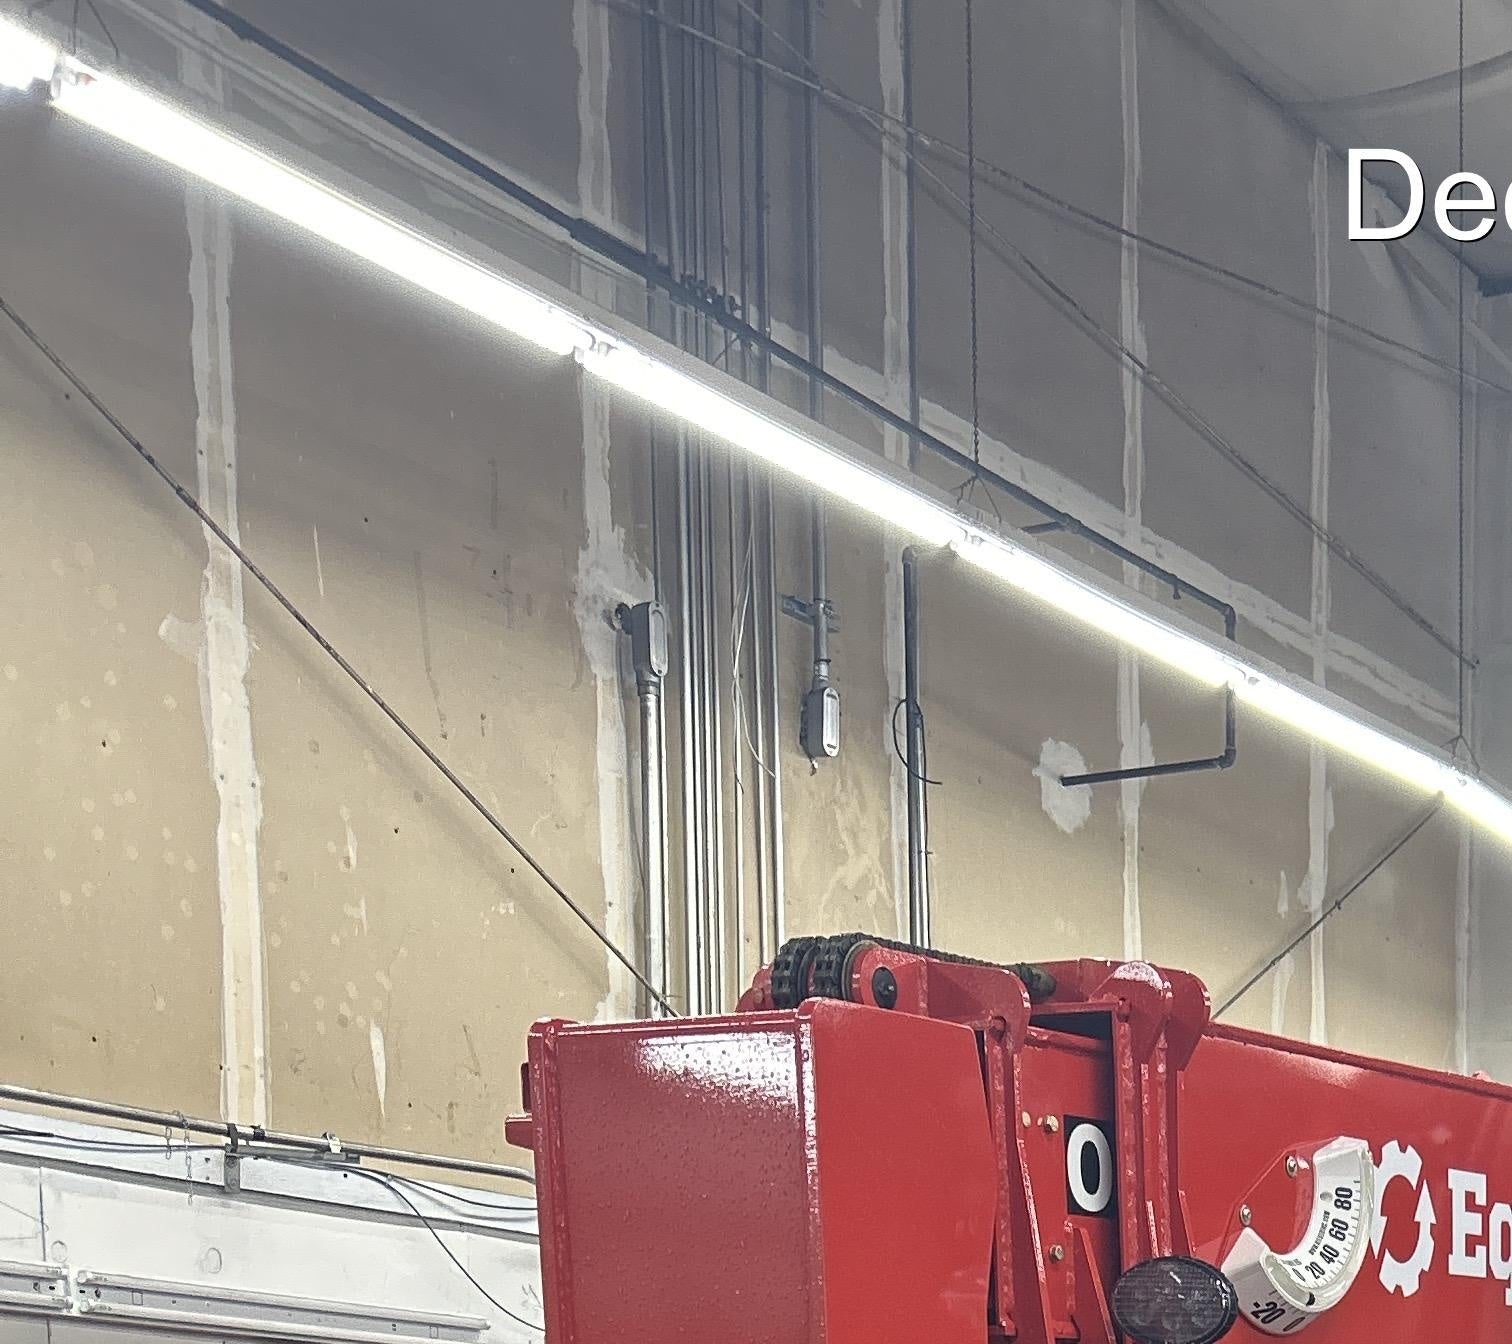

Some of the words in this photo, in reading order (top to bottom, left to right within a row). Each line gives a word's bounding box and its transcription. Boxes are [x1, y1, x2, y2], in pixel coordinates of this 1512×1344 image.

[1333, 1186, 1353, 1211] 80
[1328, 1218, 1349, 1242] 60
[1319, 1244, 1340, 1265] 40
[1305, 1261, 1326, 1280] 20
[1250, 1300, 1286, 1325] -20
